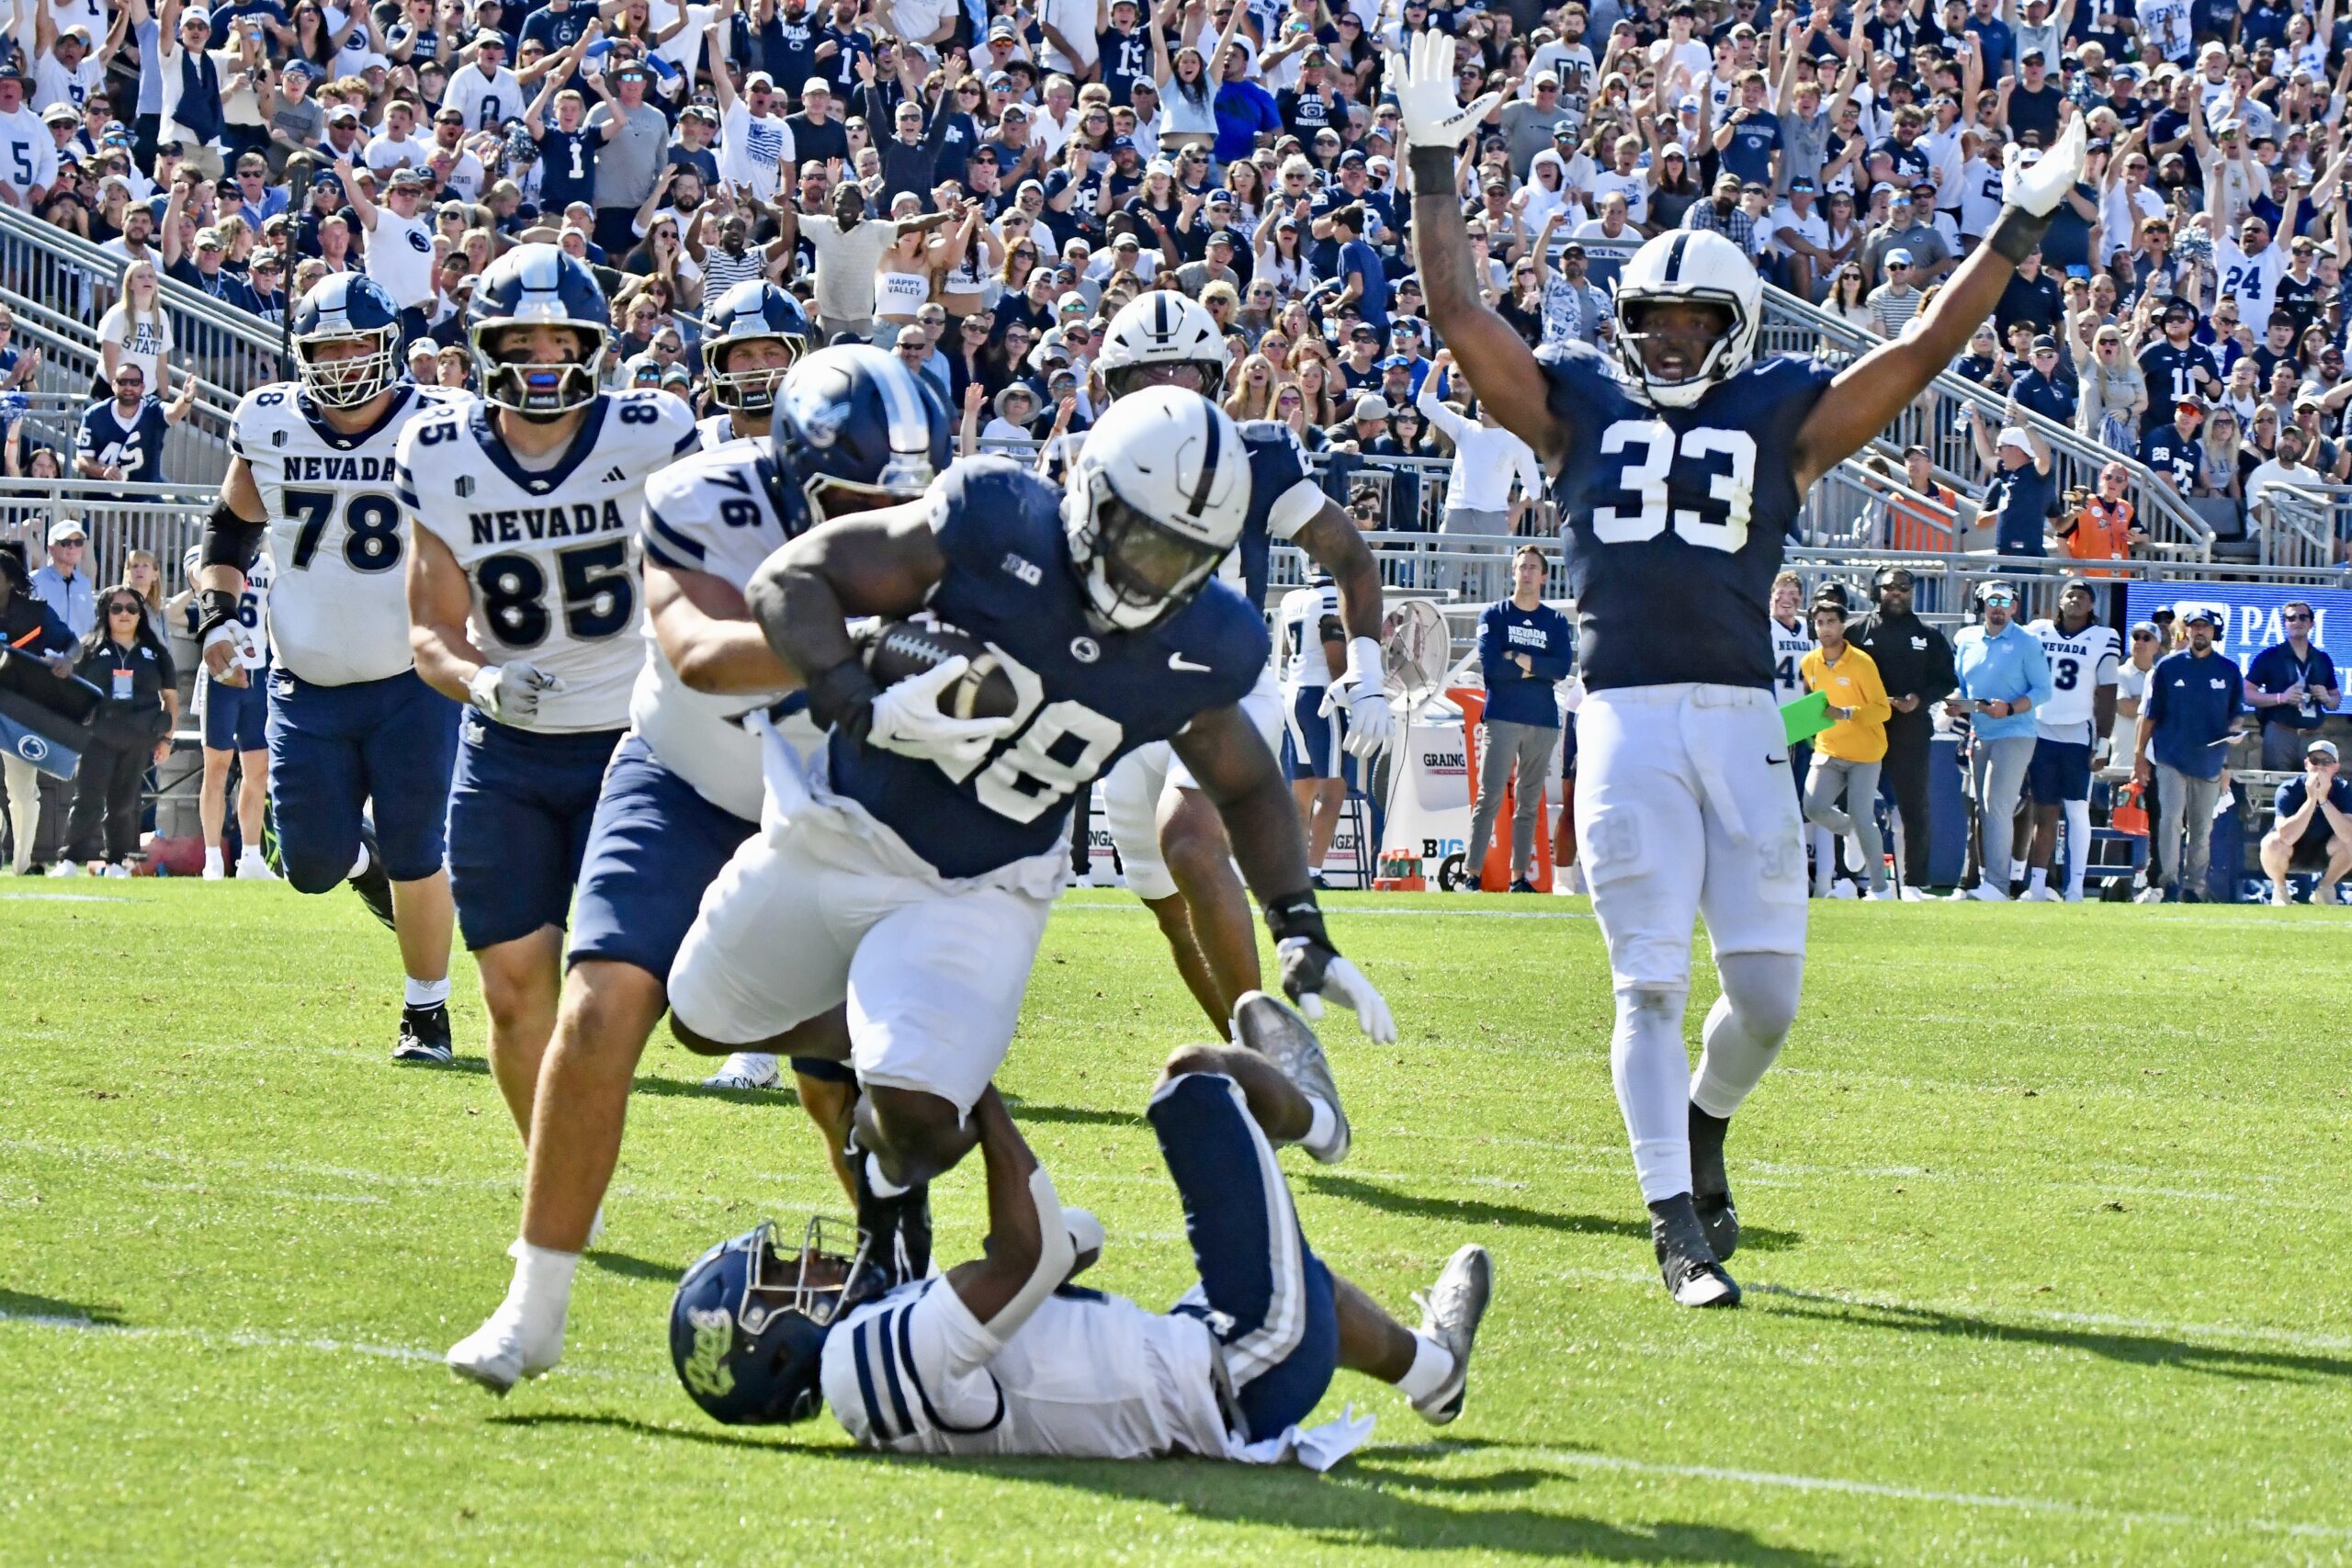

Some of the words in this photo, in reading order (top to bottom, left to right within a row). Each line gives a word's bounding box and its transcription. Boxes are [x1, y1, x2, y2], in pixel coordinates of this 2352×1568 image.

[837, 47, 853, 85] 1
[1115, 39, 1146, 77] 15
[11, 141, 33, 186] 5
[568, 142, 585, 179] 1
[888, 278, 921, 288] HAPPY
[888, 286, 922, 296] VALLEY
[2222, 265, 2262, 300] 24
[137, 321, 164, 341] EN
[282, 456, 396, 482] NEVADA
[1592, 419, 1758, 554] 33
[280, 484, 405, 576] 78
[469, 498, 625, 546] NEVADA
[474, 537, 637, 651] 85
[1508, 626, 1548, 642] NEVADA
[1508, 634, 1547, 649] FOOTBALL
[1423, 753, 1466, 768] GRAING
